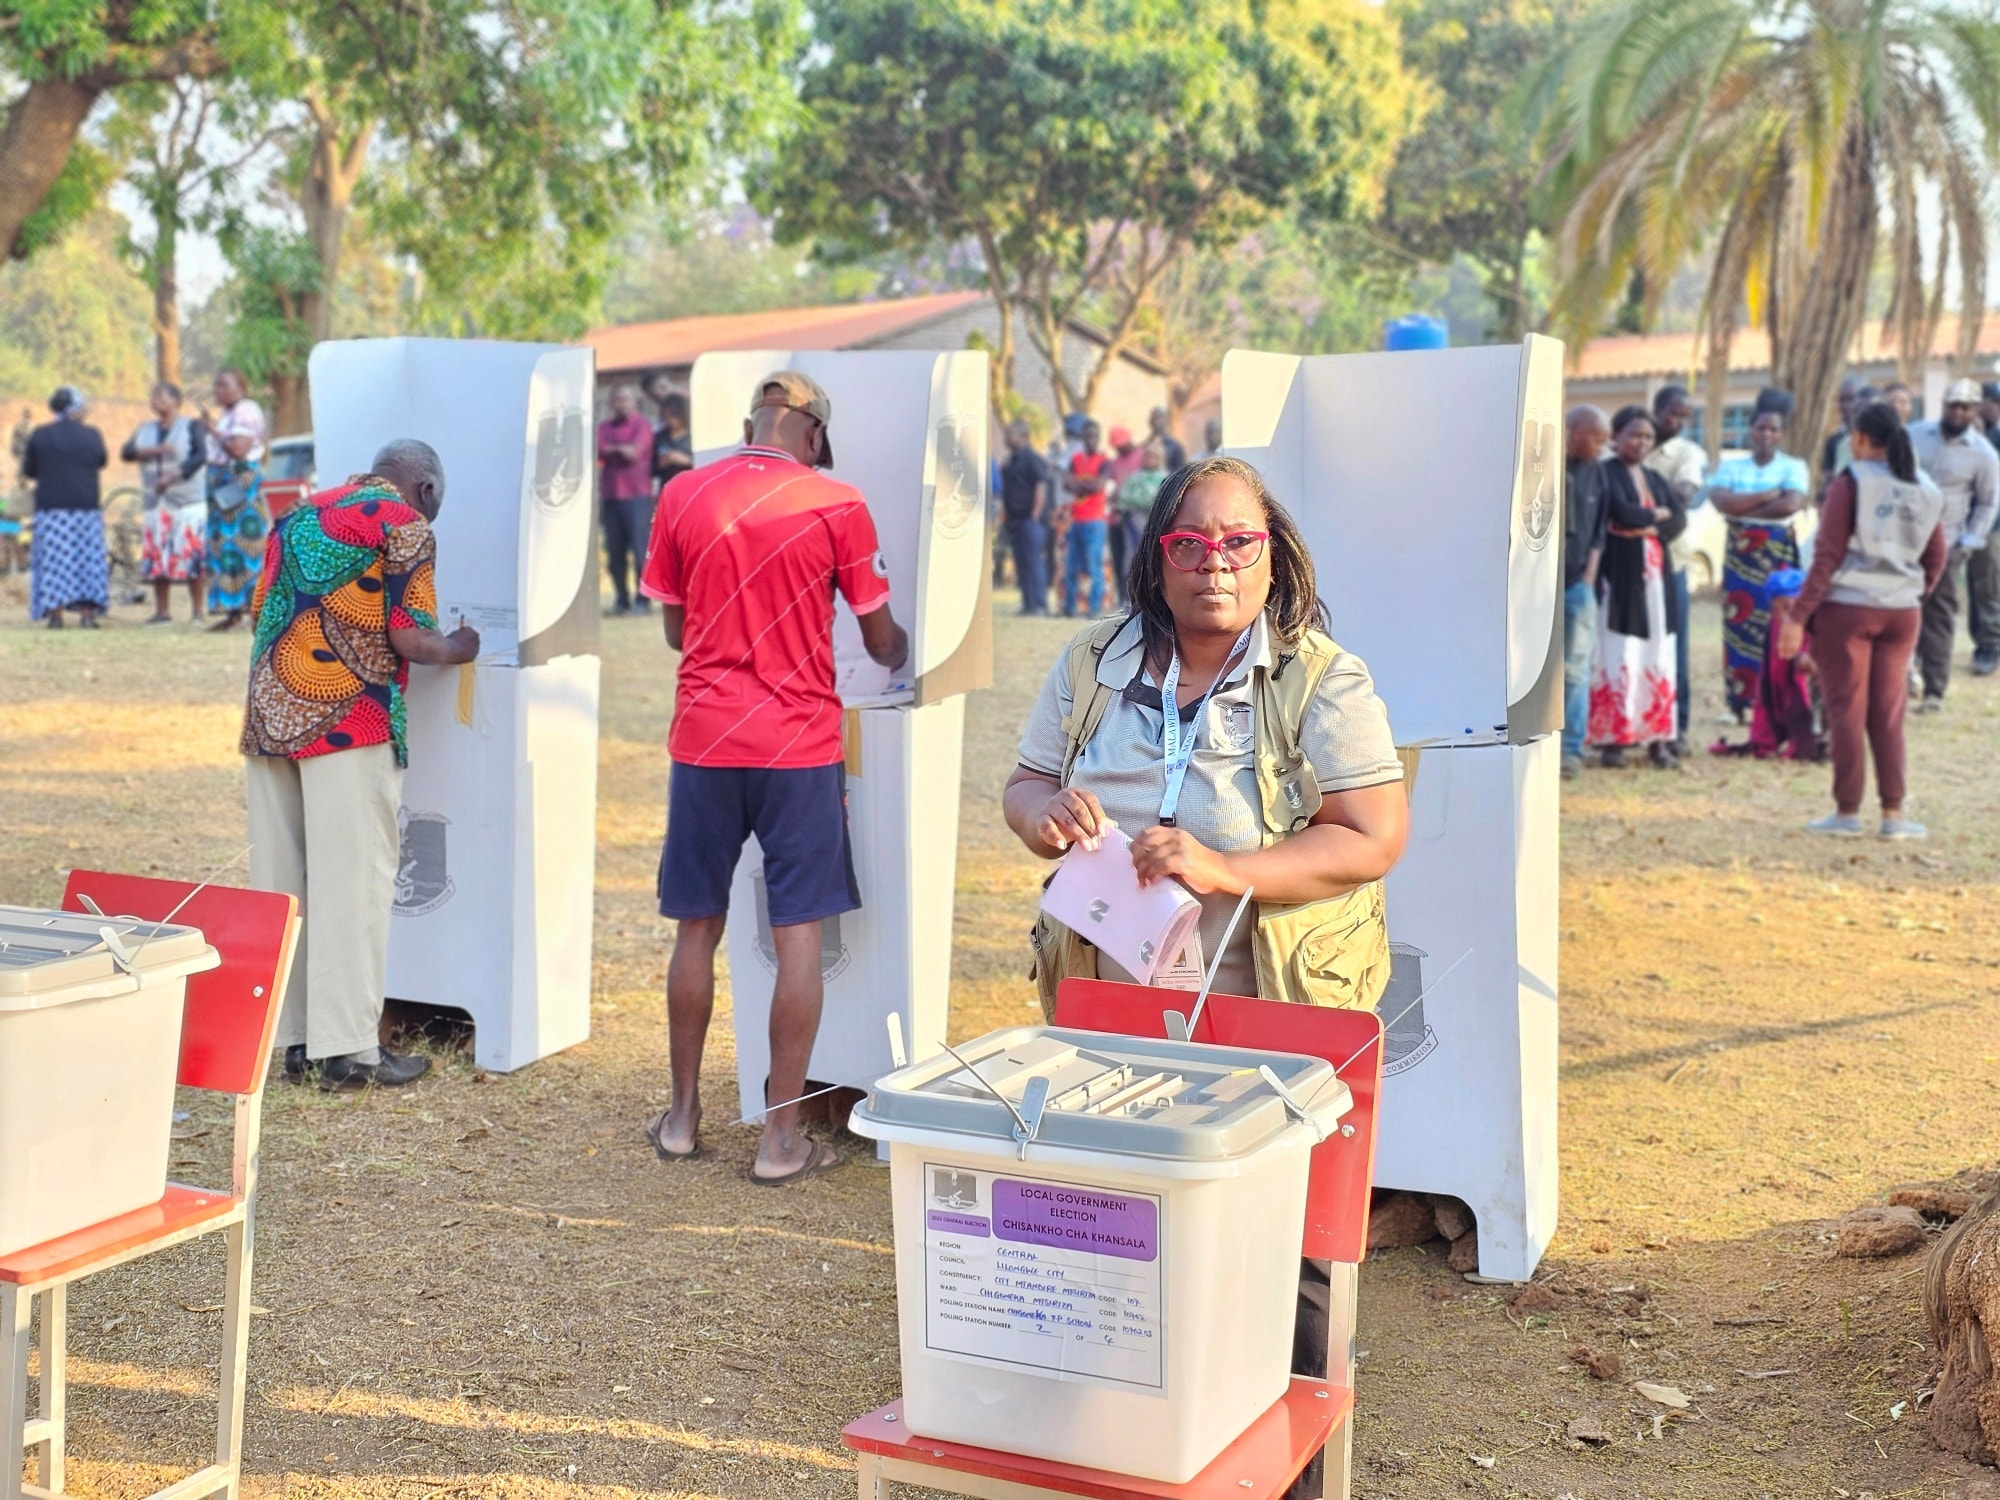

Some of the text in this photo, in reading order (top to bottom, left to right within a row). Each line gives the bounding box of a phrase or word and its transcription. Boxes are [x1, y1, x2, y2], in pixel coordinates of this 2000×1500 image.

[1168, 718, 1177, 757] MALAWI
[1386, 1041, 1432, 1073] COMMISSION
[1020, 1187, 1127, 1212] LOCAL GOVERNMENT
[1050, 1207, 1096, 1223] ELECTION
[964, 1220, 987, 1228] ELECTION
[1003, 1219, 1146, 1250] CHISANKHO CHA KHANSALA
[997, 1247, 1038, 1260] CENTRAL
[1047, 1269, 1064, 1279] CITY
[940, 1298, 1006, 1315] POLLING STATION NAME:
[940, 1312, 963, 1322] POLLING
[964, 1316, 987, 1326] STATION
[1036, 1324, 1052, 1334] 2
[1075, 1334, 1084, 1342] OF
